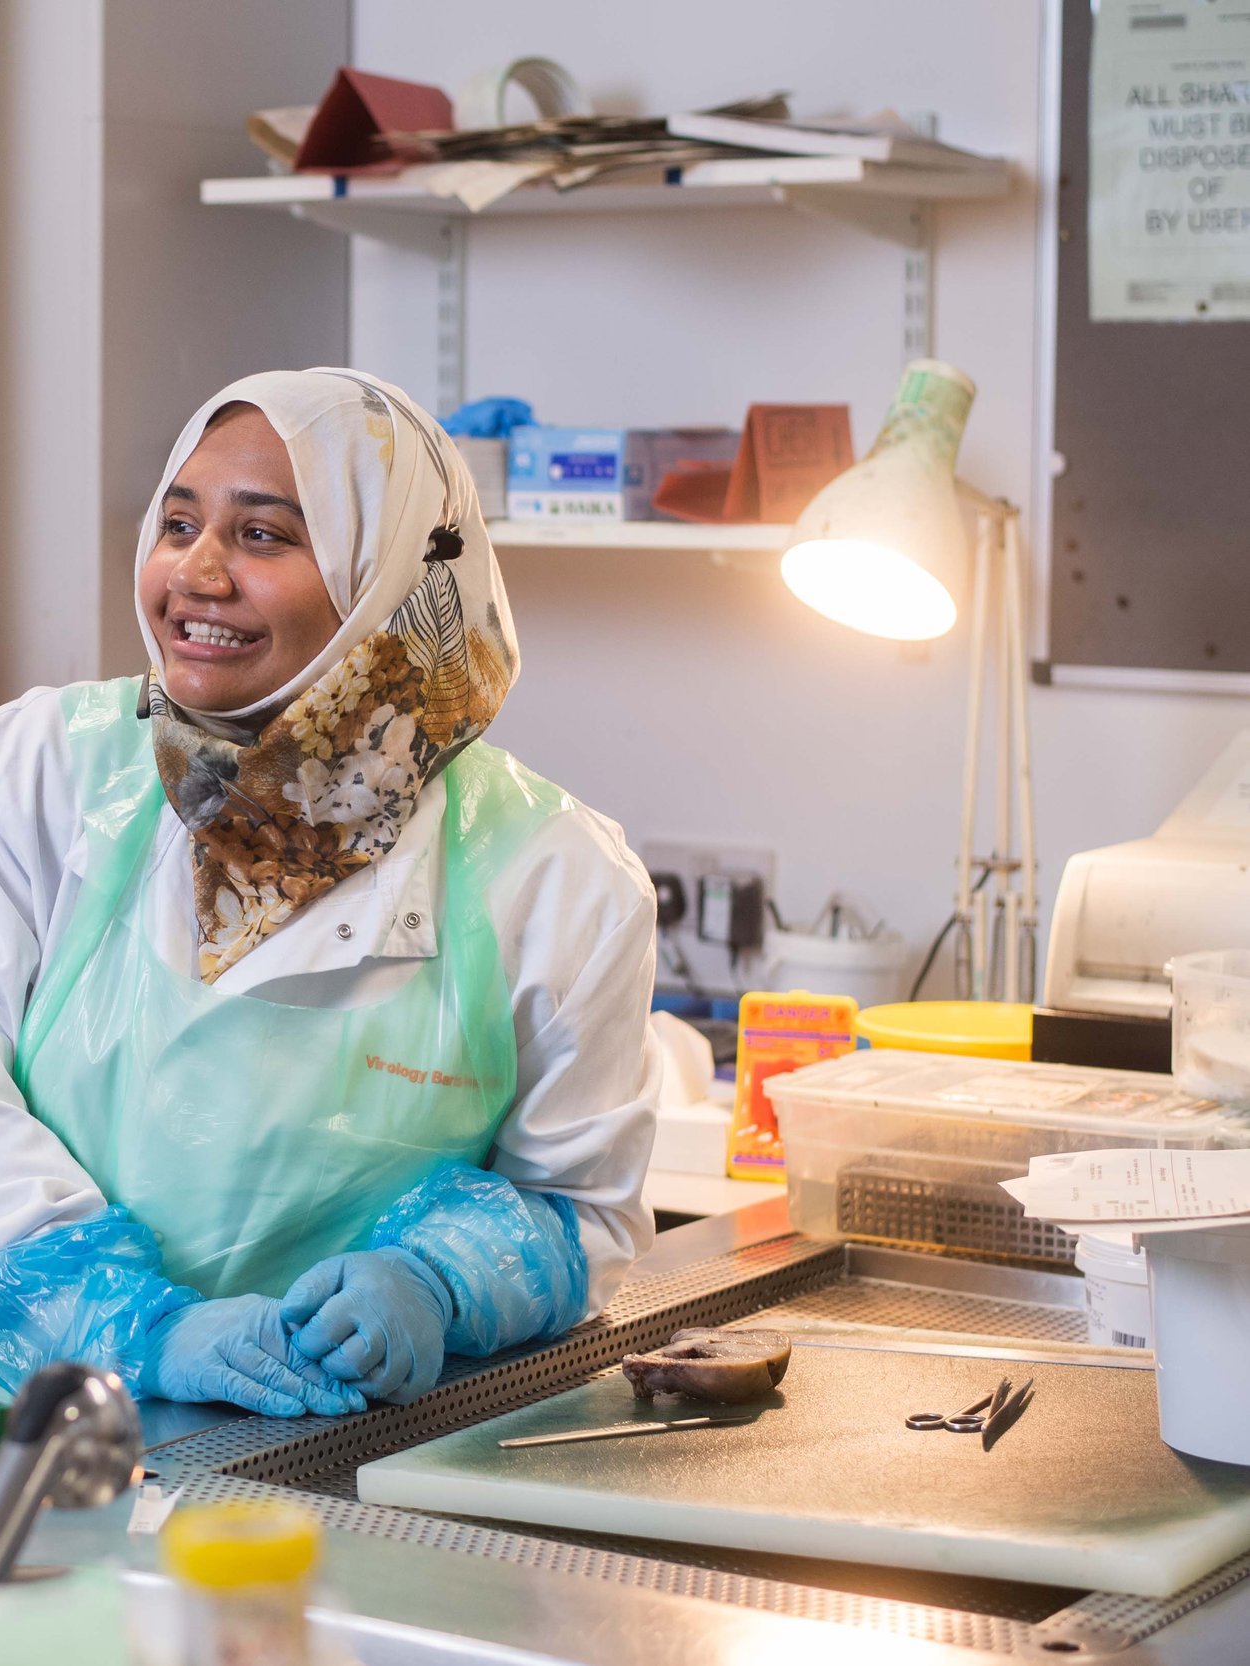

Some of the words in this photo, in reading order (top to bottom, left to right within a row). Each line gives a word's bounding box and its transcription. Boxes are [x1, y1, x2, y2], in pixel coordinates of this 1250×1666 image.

[1125, 83, 1172, 109] ALL
[1148, 112, 1221, 140] MUST
[1187, 175, 1226, 203] OF
[1145, 208, 1182, 235] BY
[764, 1005, 830, 1020] DANGER
[366, 1054, 427, 1085] Virology
